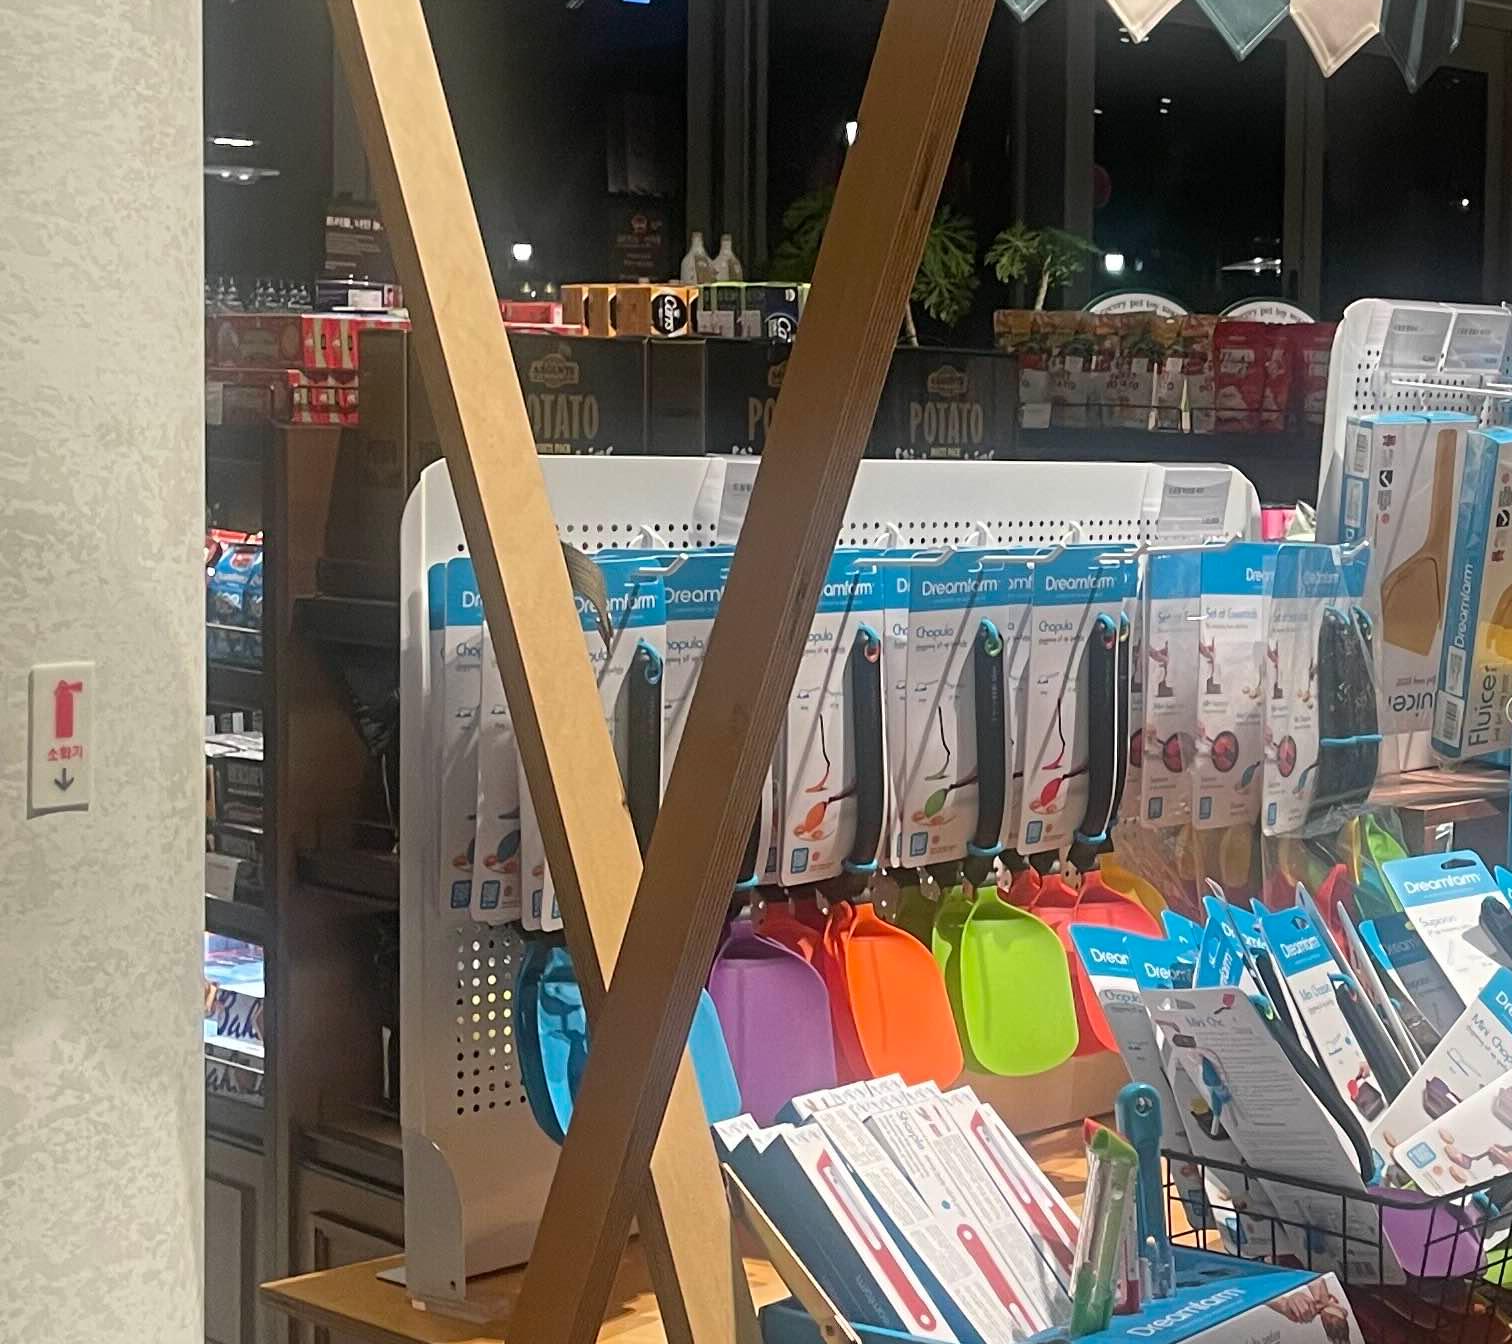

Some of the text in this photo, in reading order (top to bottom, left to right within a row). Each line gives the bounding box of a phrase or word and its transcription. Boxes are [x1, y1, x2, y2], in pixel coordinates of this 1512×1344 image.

[910, 401, 984, 445] POTATO
[921, 578, 999, 597] Dreamfarm
[1045, 574, 1115, 592] Dreamfarm
[1453, 563, 1474, 649] Dreamfarm
[1468, 665, 1498, 746] Fluicer
[47, 745, 84, 761] 소화기
[1403, 872, 1481, 894] Dreamfarm
[1126, 1287, 1247, 1337] Dreamfarm
